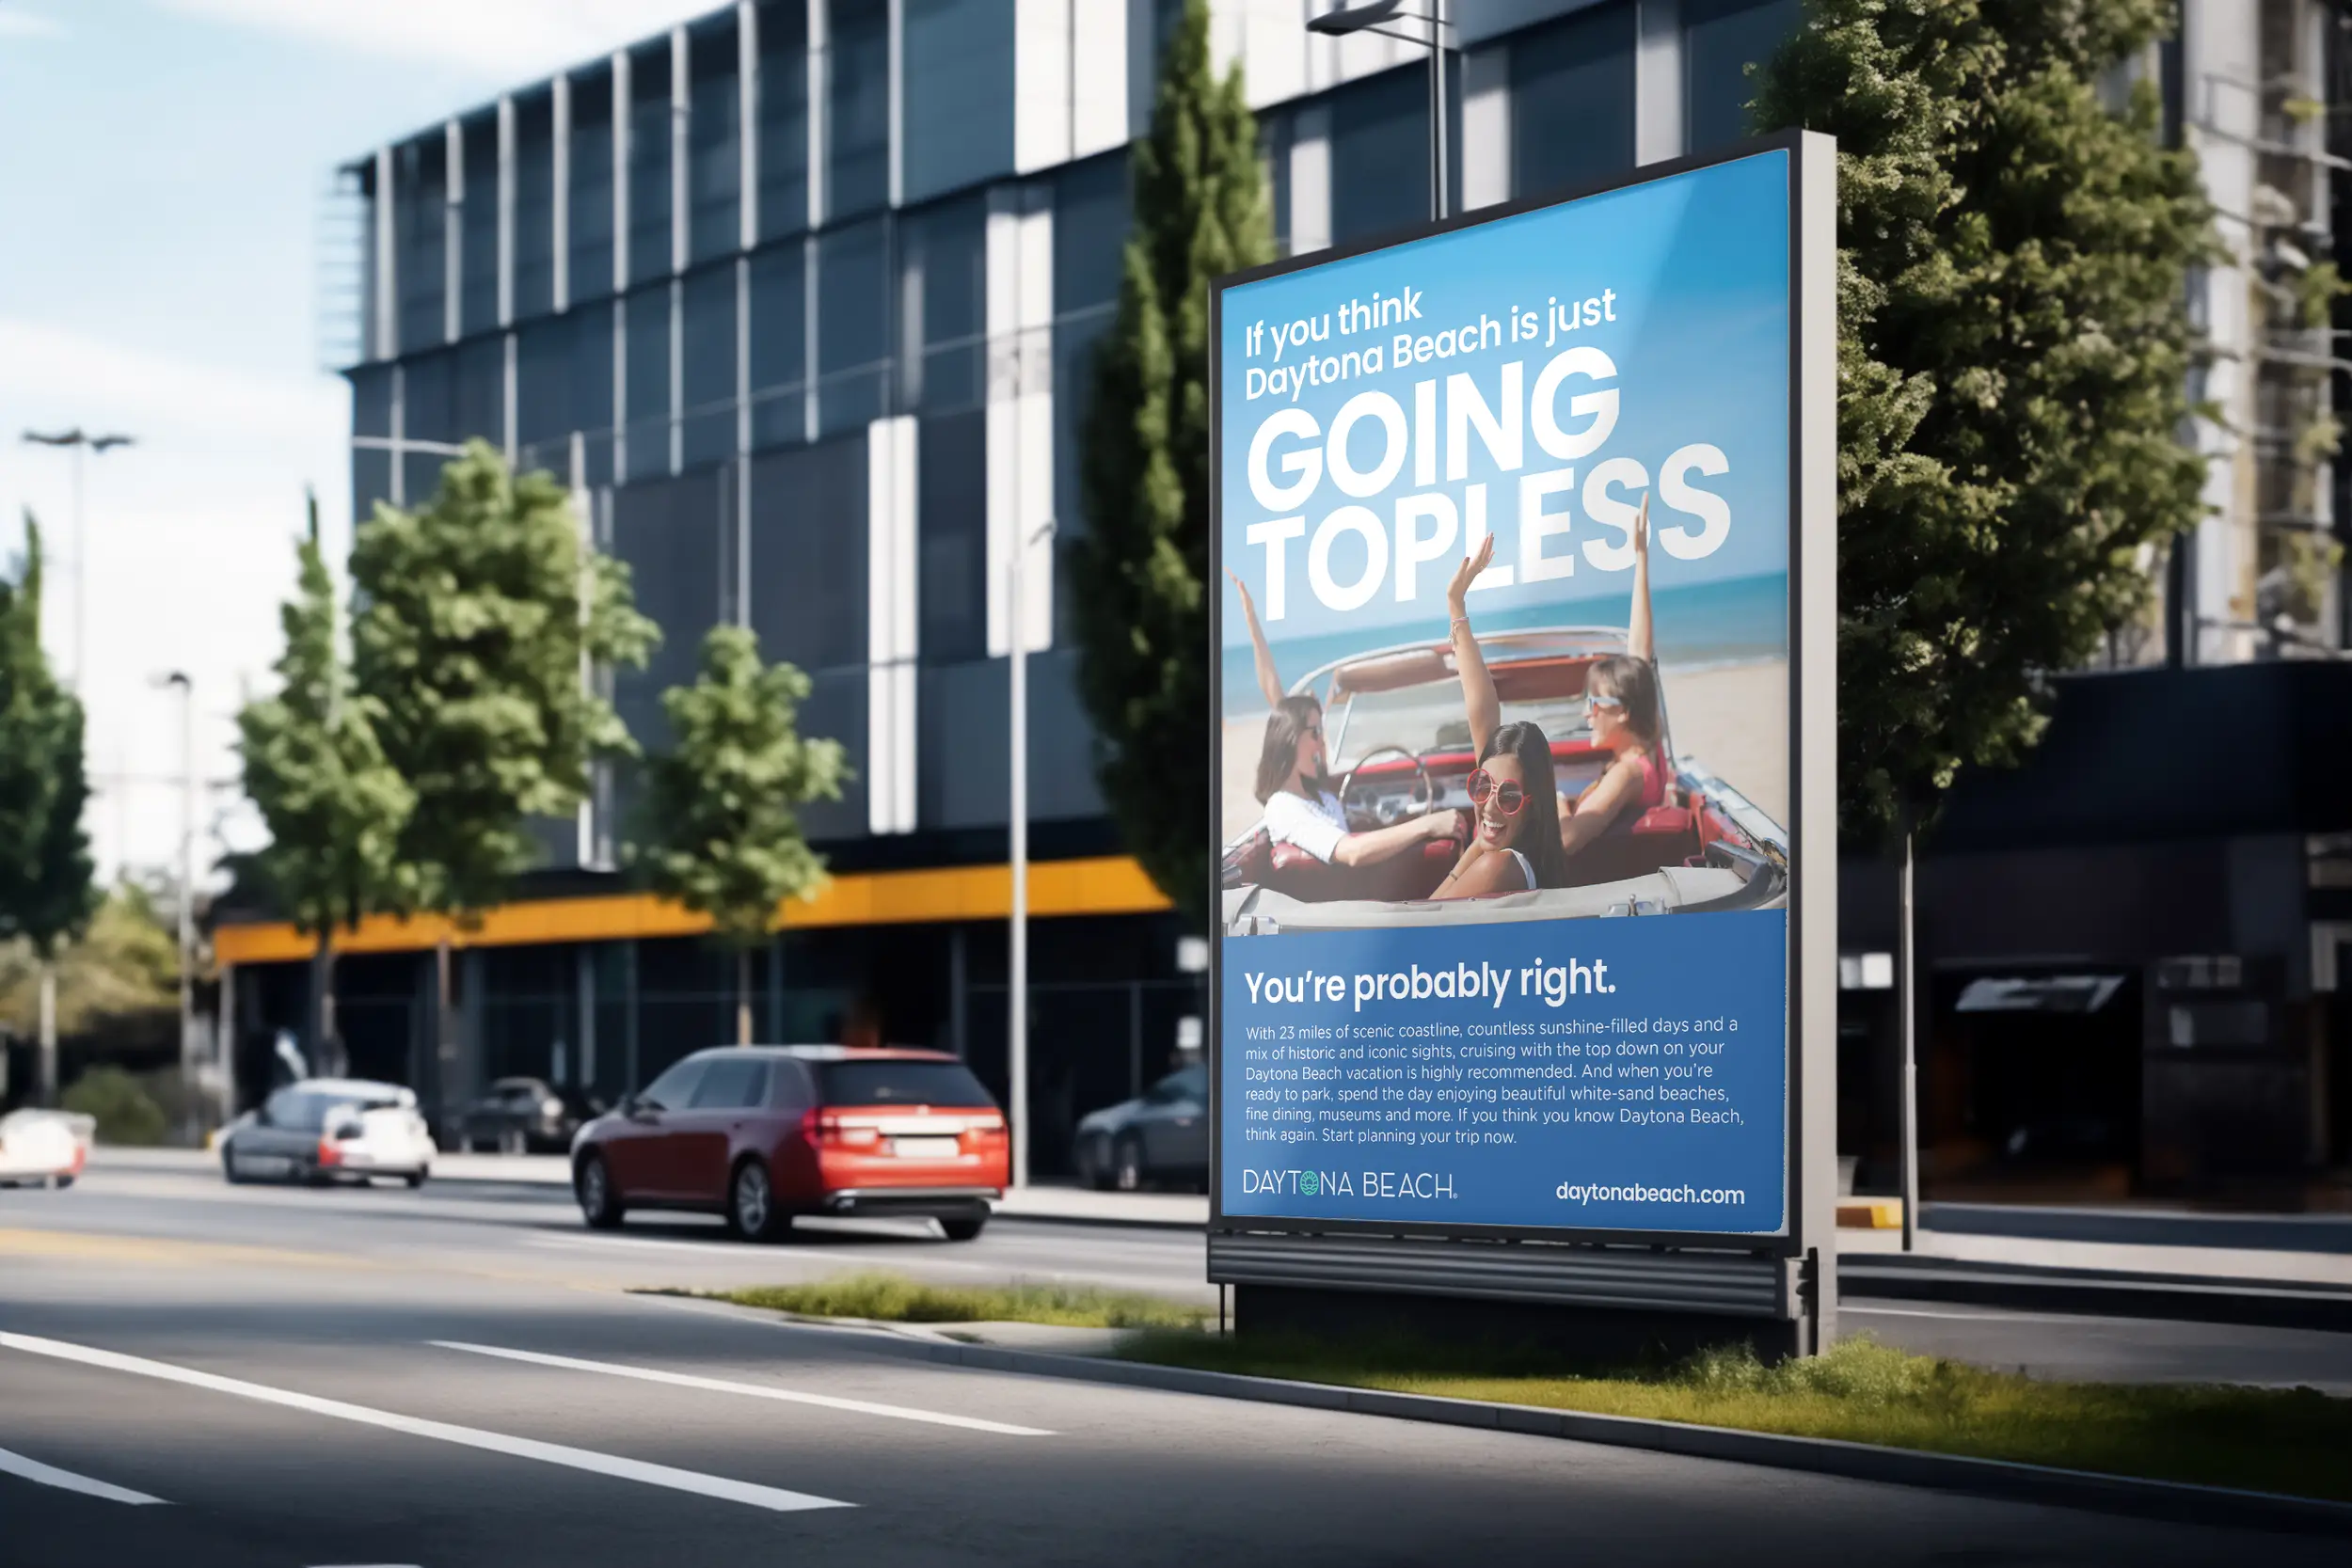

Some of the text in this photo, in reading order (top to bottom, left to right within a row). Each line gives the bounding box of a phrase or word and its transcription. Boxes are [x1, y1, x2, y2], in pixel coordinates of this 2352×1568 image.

[1246, 286, 1423, 363] If you think
[1246, 288, 1617, 403] Daytona Beach is just
[1248, 346, 1620, 512] GOING
[1246, 442, 1731, 621] TOPLESS
[1354, 961, 1513, 1013] probably
[1520, 958, 1616, 1008] right.
[1245, 1015, 1739, 1040] With 23 miles of scenic coastline, countless sunshine-filled days and a
[1246, 1039, 1725, 1061] mix of historic and iconic sights, cruising with the top down on your
[1246, 1067, 1298, 1084] Daytona
[1302, 1065, 1343, 1081] Beach
[1345, 1065, 1403, 1081] vacation
[1406, 1065, 1418, 1080] is
[1421, 1064, 1464, 1083] highly
[1468, 1063, 1577, 1080] recommended.
[1581, 1062, 1613, 1079] And
[1617, 1062, 1660, 1079] when
[1246, 1085, 1729, 1103] ready to park, spend the day enjoying beautiful white-sand beaches,
[1245, 1106, 1744, 1126] fine dining, museums and more. If you think you know Daytona Beach,
[1245, 1126, 1518, 1147] think again. Start planning your trip now.
[1556, 1181, 1744, 1206] daytonabeach.com
